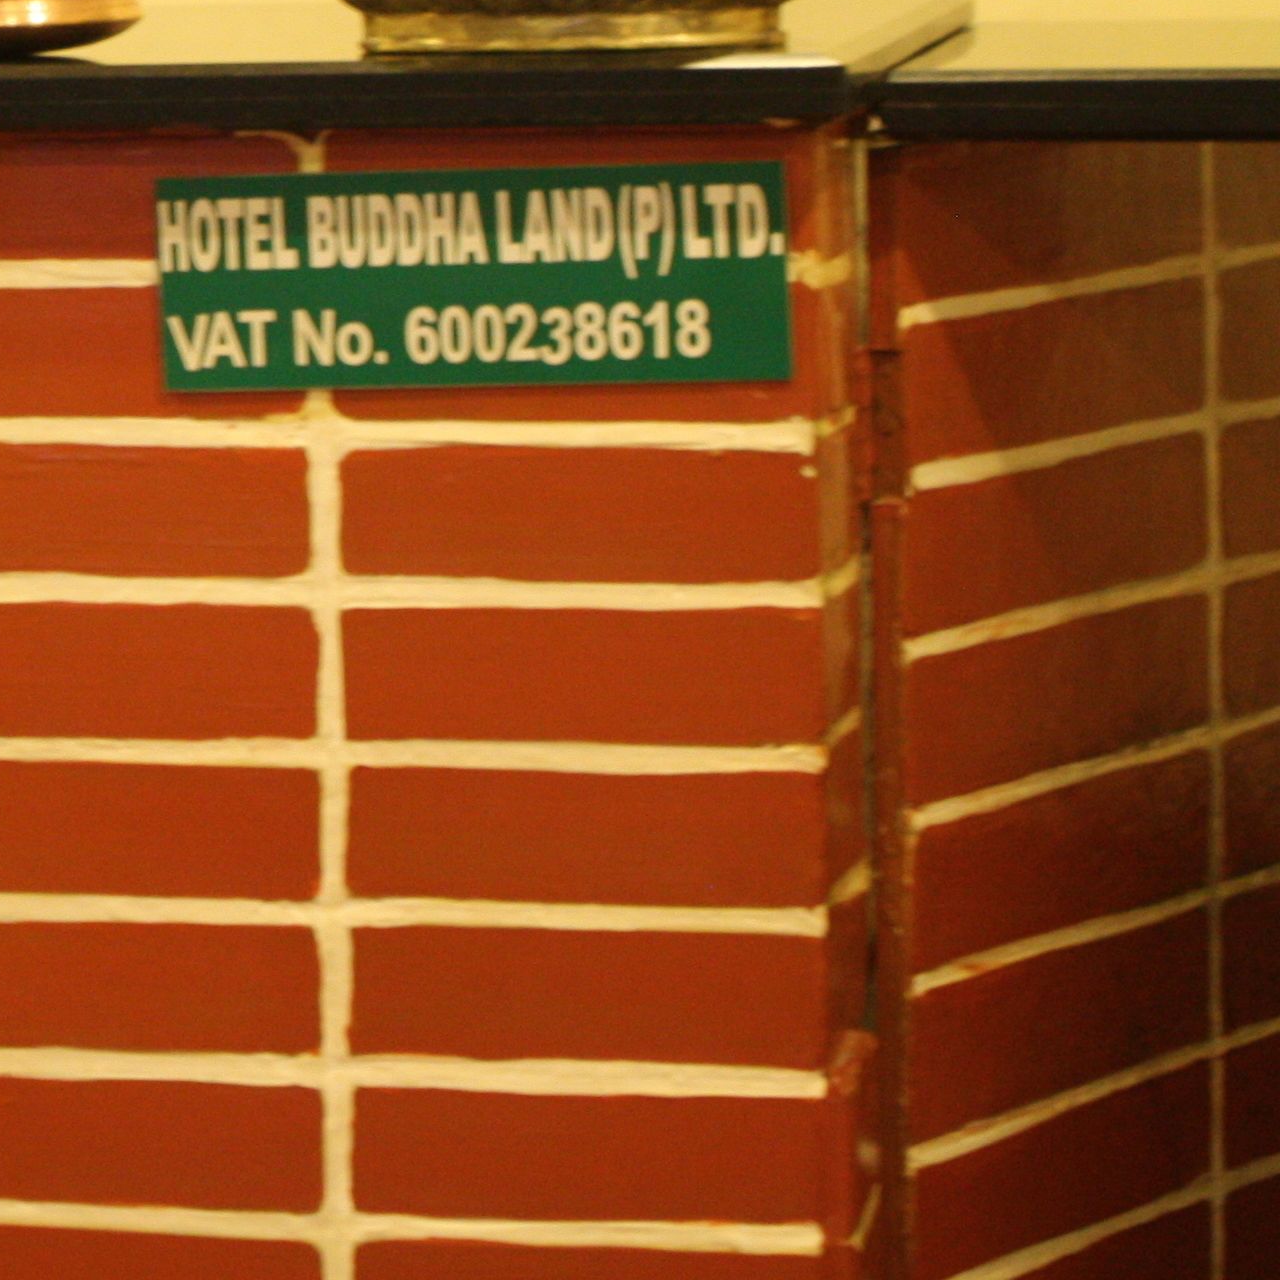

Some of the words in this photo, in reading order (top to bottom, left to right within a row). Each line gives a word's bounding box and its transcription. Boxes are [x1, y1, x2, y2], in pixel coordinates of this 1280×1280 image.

[156, 196, 300, 272] HOTEL
[306, 191, 490, 269] BUDDHA
[681, 182, 786, 259] LTD.
[165, 309, 278, 371] VAT
[292, 308, 390, 366] No.
[404, 297, 712, 365] 600238618
